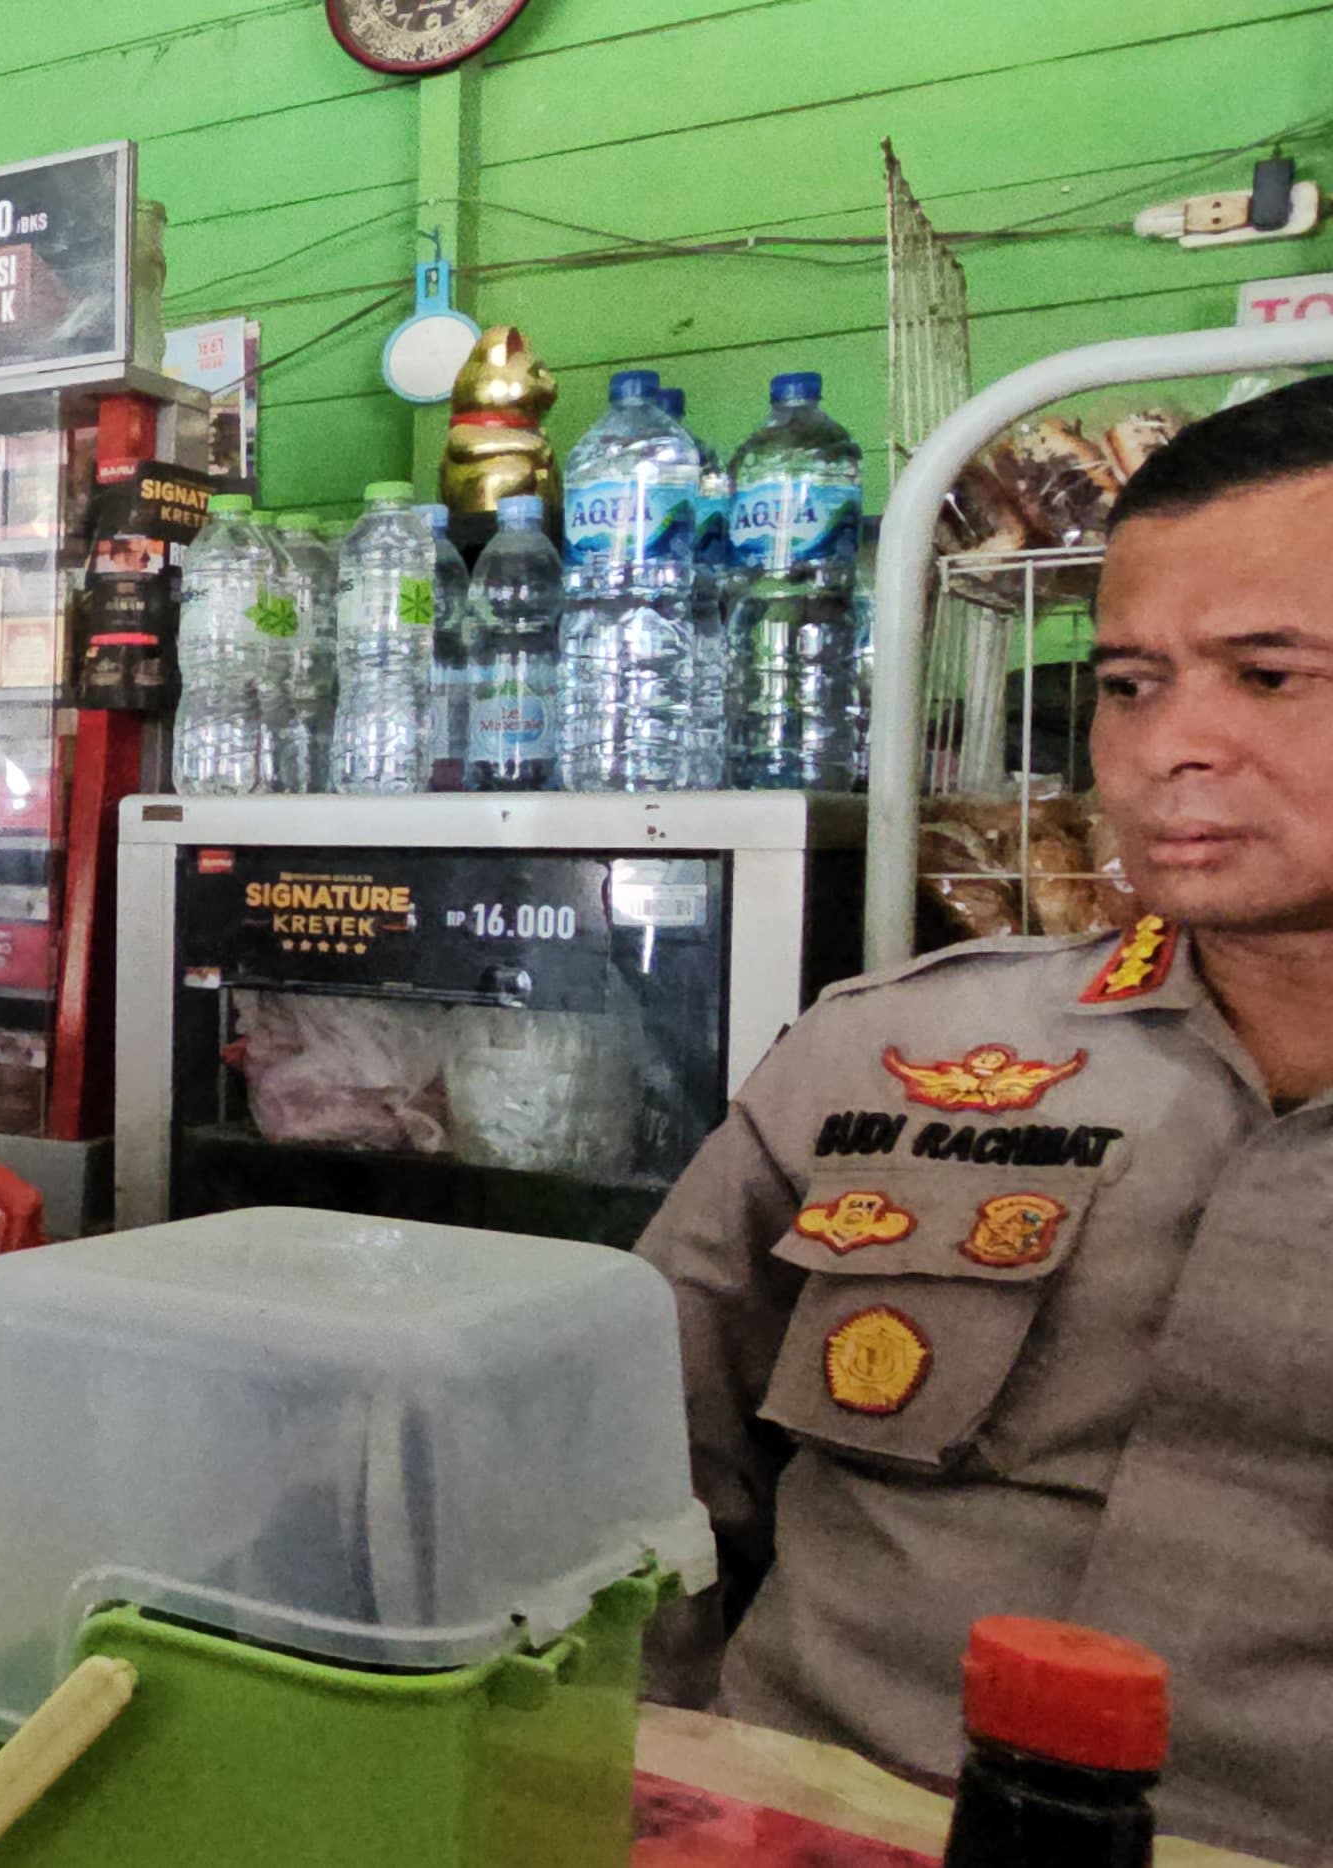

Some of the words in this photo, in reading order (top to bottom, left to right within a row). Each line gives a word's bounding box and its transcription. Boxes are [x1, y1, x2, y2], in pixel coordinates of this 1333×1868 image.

[141, 479, 208, 510] SIGNAT
[245, 883, 410, 912] SIGNATURE
[273, 914, 376, 937] KRETEK
[447, 911, 465, 928] RP
[472, 903, 575, 940] 16.000
[815, 1110, 908, 1157] BUDI
[911, 1121, 1123, 1167] RACHMAT
